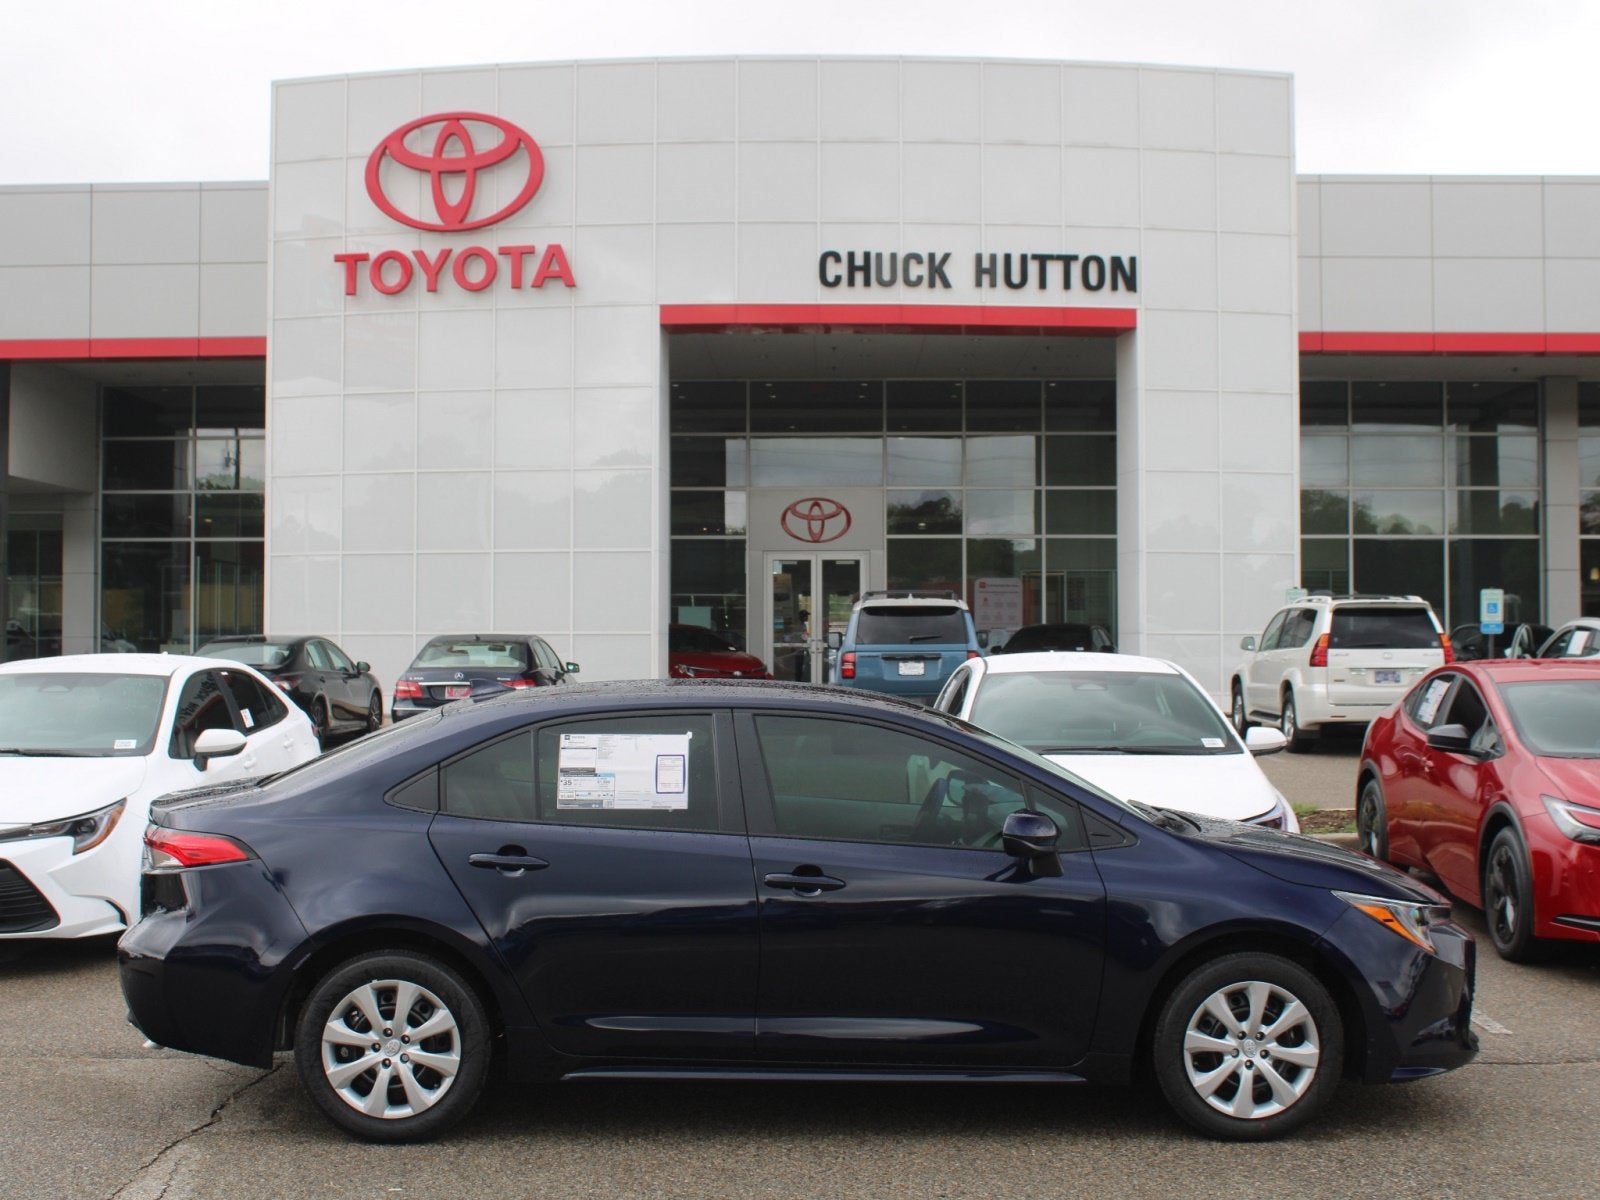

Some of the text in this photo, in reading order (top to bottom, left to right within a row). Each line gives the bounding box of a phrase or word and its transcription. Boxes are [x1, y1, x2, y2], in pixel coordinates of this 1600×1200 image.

[334, 244, 576, 296] TOYOTA
[819, 251, 1137, 293] CHUCK HUTTON
